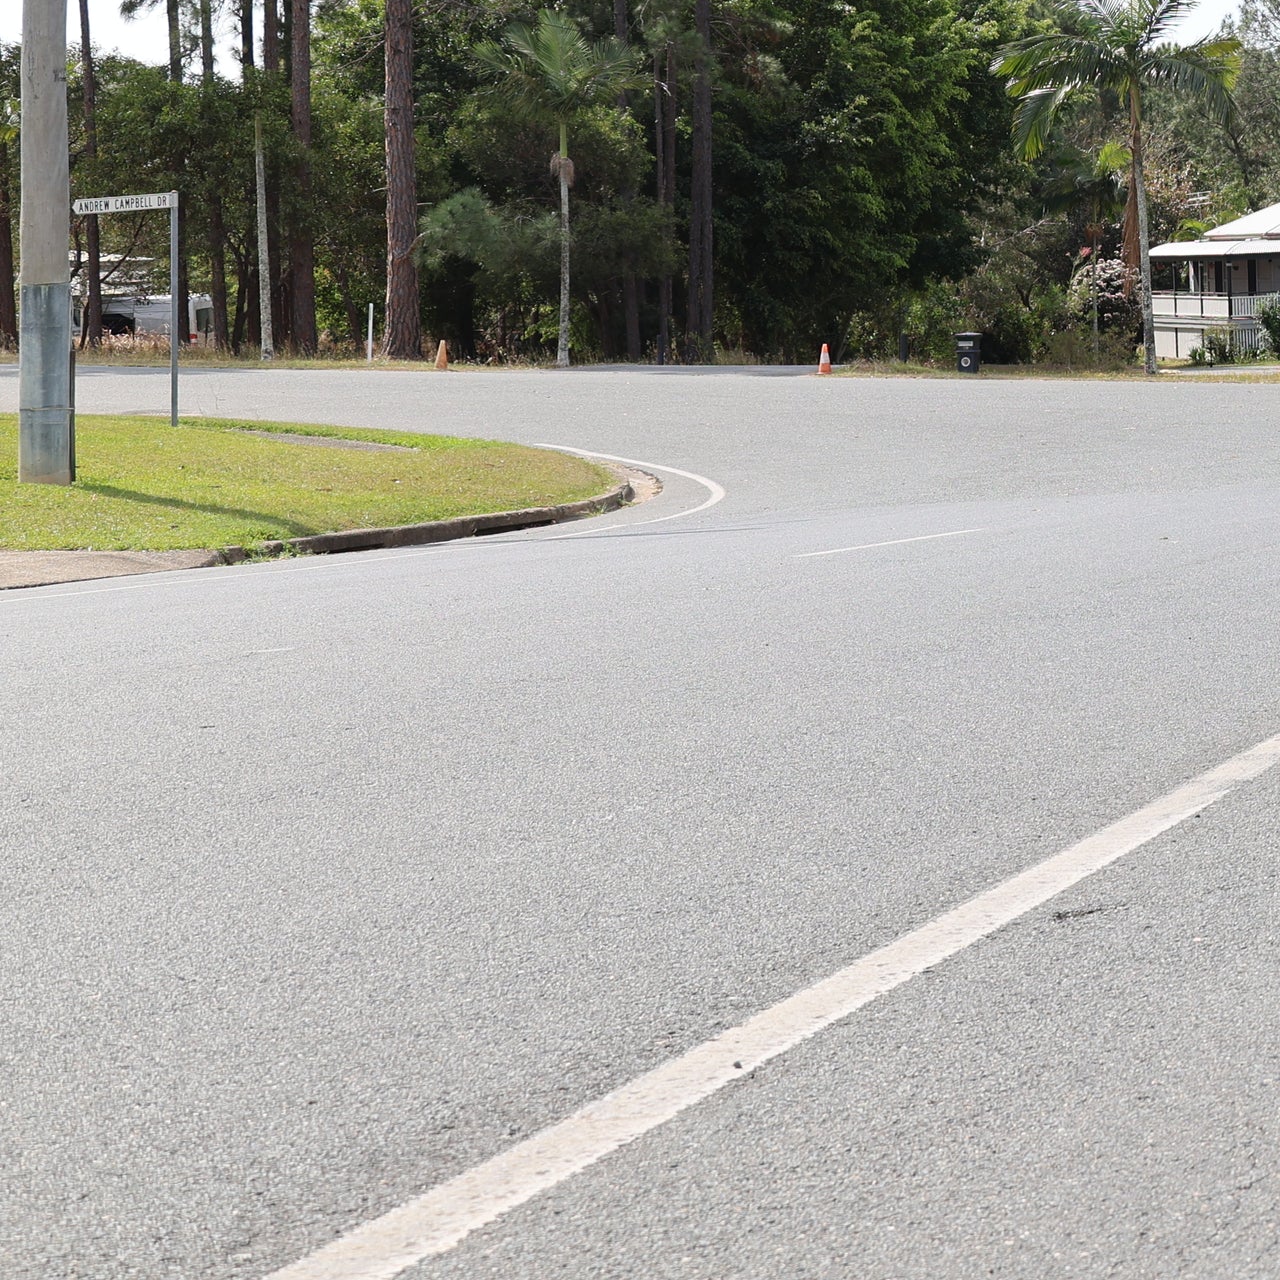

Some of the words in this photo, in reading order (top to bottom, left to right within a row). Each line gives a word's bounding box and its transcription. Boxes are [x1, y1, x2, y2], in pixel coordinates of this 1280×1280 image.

[79, 200, 110, 212] ANDREW
[115, 197, 153, 209] CAMPBELL
[157, 196, 167, 206] DR
